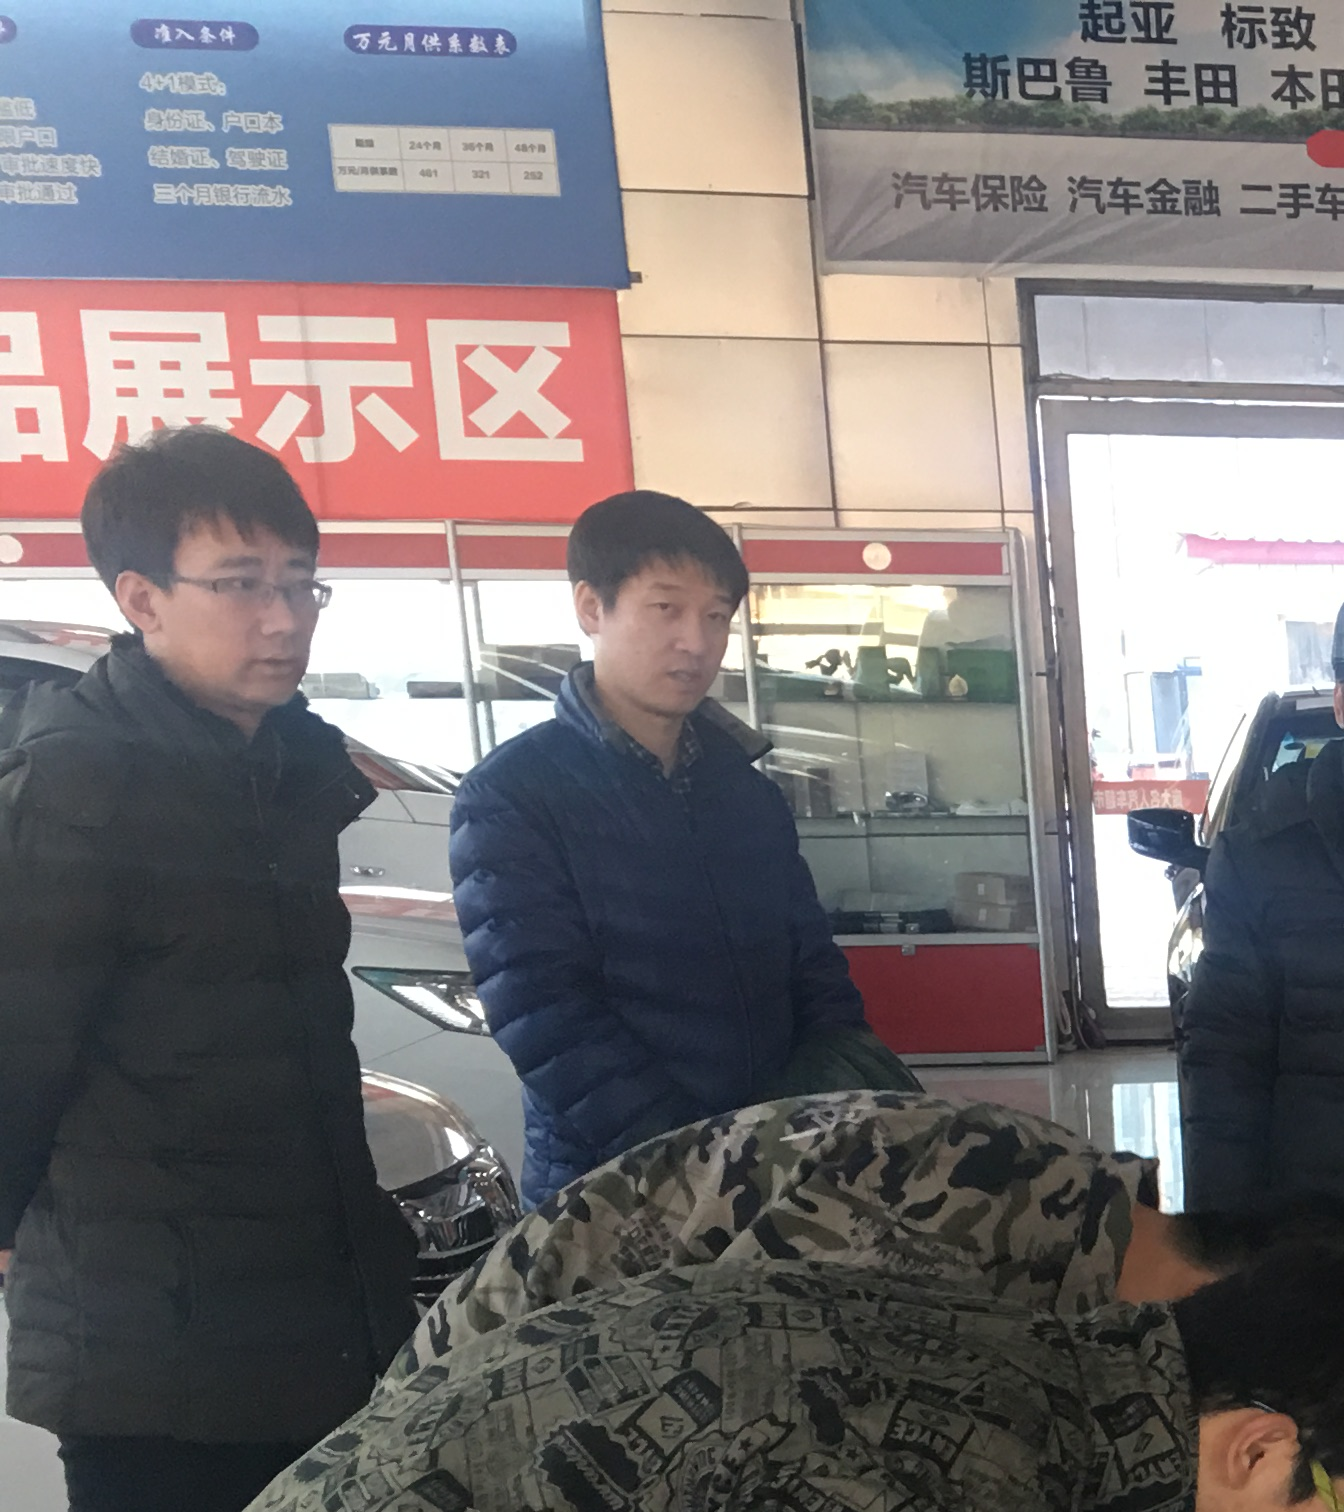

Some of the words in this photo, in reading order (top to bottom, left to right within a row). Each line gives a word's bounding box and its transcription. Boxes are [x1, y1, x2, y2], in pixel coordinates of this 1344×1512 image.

[154, 23, 236, 46] 准入条件
[352, 31, 510, 55] 万元月供系数表
[1079, 0, 1178, 45] 起亚
[1221, 3, 1316, 52] 标致
[962, 52, 1112, 104] 斯巴鲁
[1144, 60, 1239, 108] 丰田
[891, 171, 1048, 214] 汽车保险
[1068, 177, 1222, 218] 汽车金融
